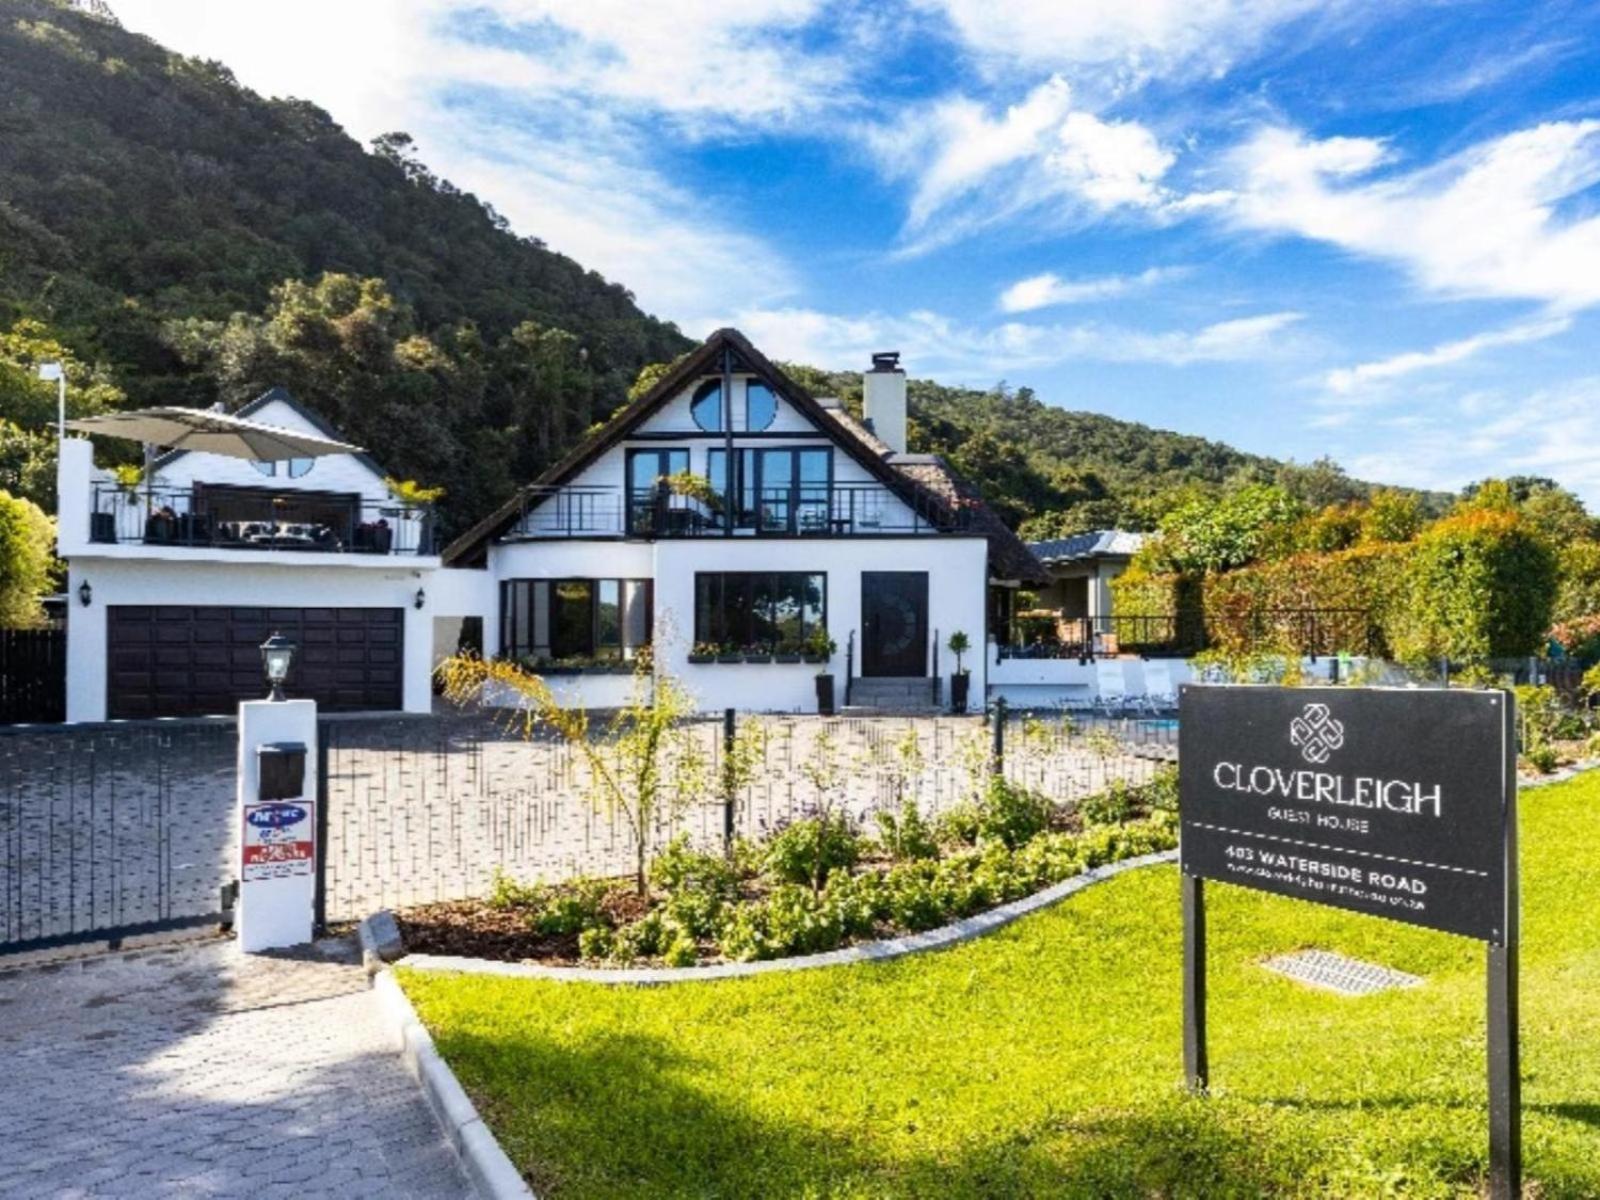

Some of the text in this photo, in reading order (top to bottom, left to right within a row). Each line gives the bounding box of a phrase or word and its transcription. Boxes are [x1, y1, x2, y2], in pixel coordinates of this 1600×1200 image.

[1213, 762, 1441, 817] CLOVERLEIGH
[1267, 806, 1369, 833] GUEST HOUSE
[1259, 850, 1362, 882] WATERSIDE
[1369, 872, 1428, 894] ROAD
